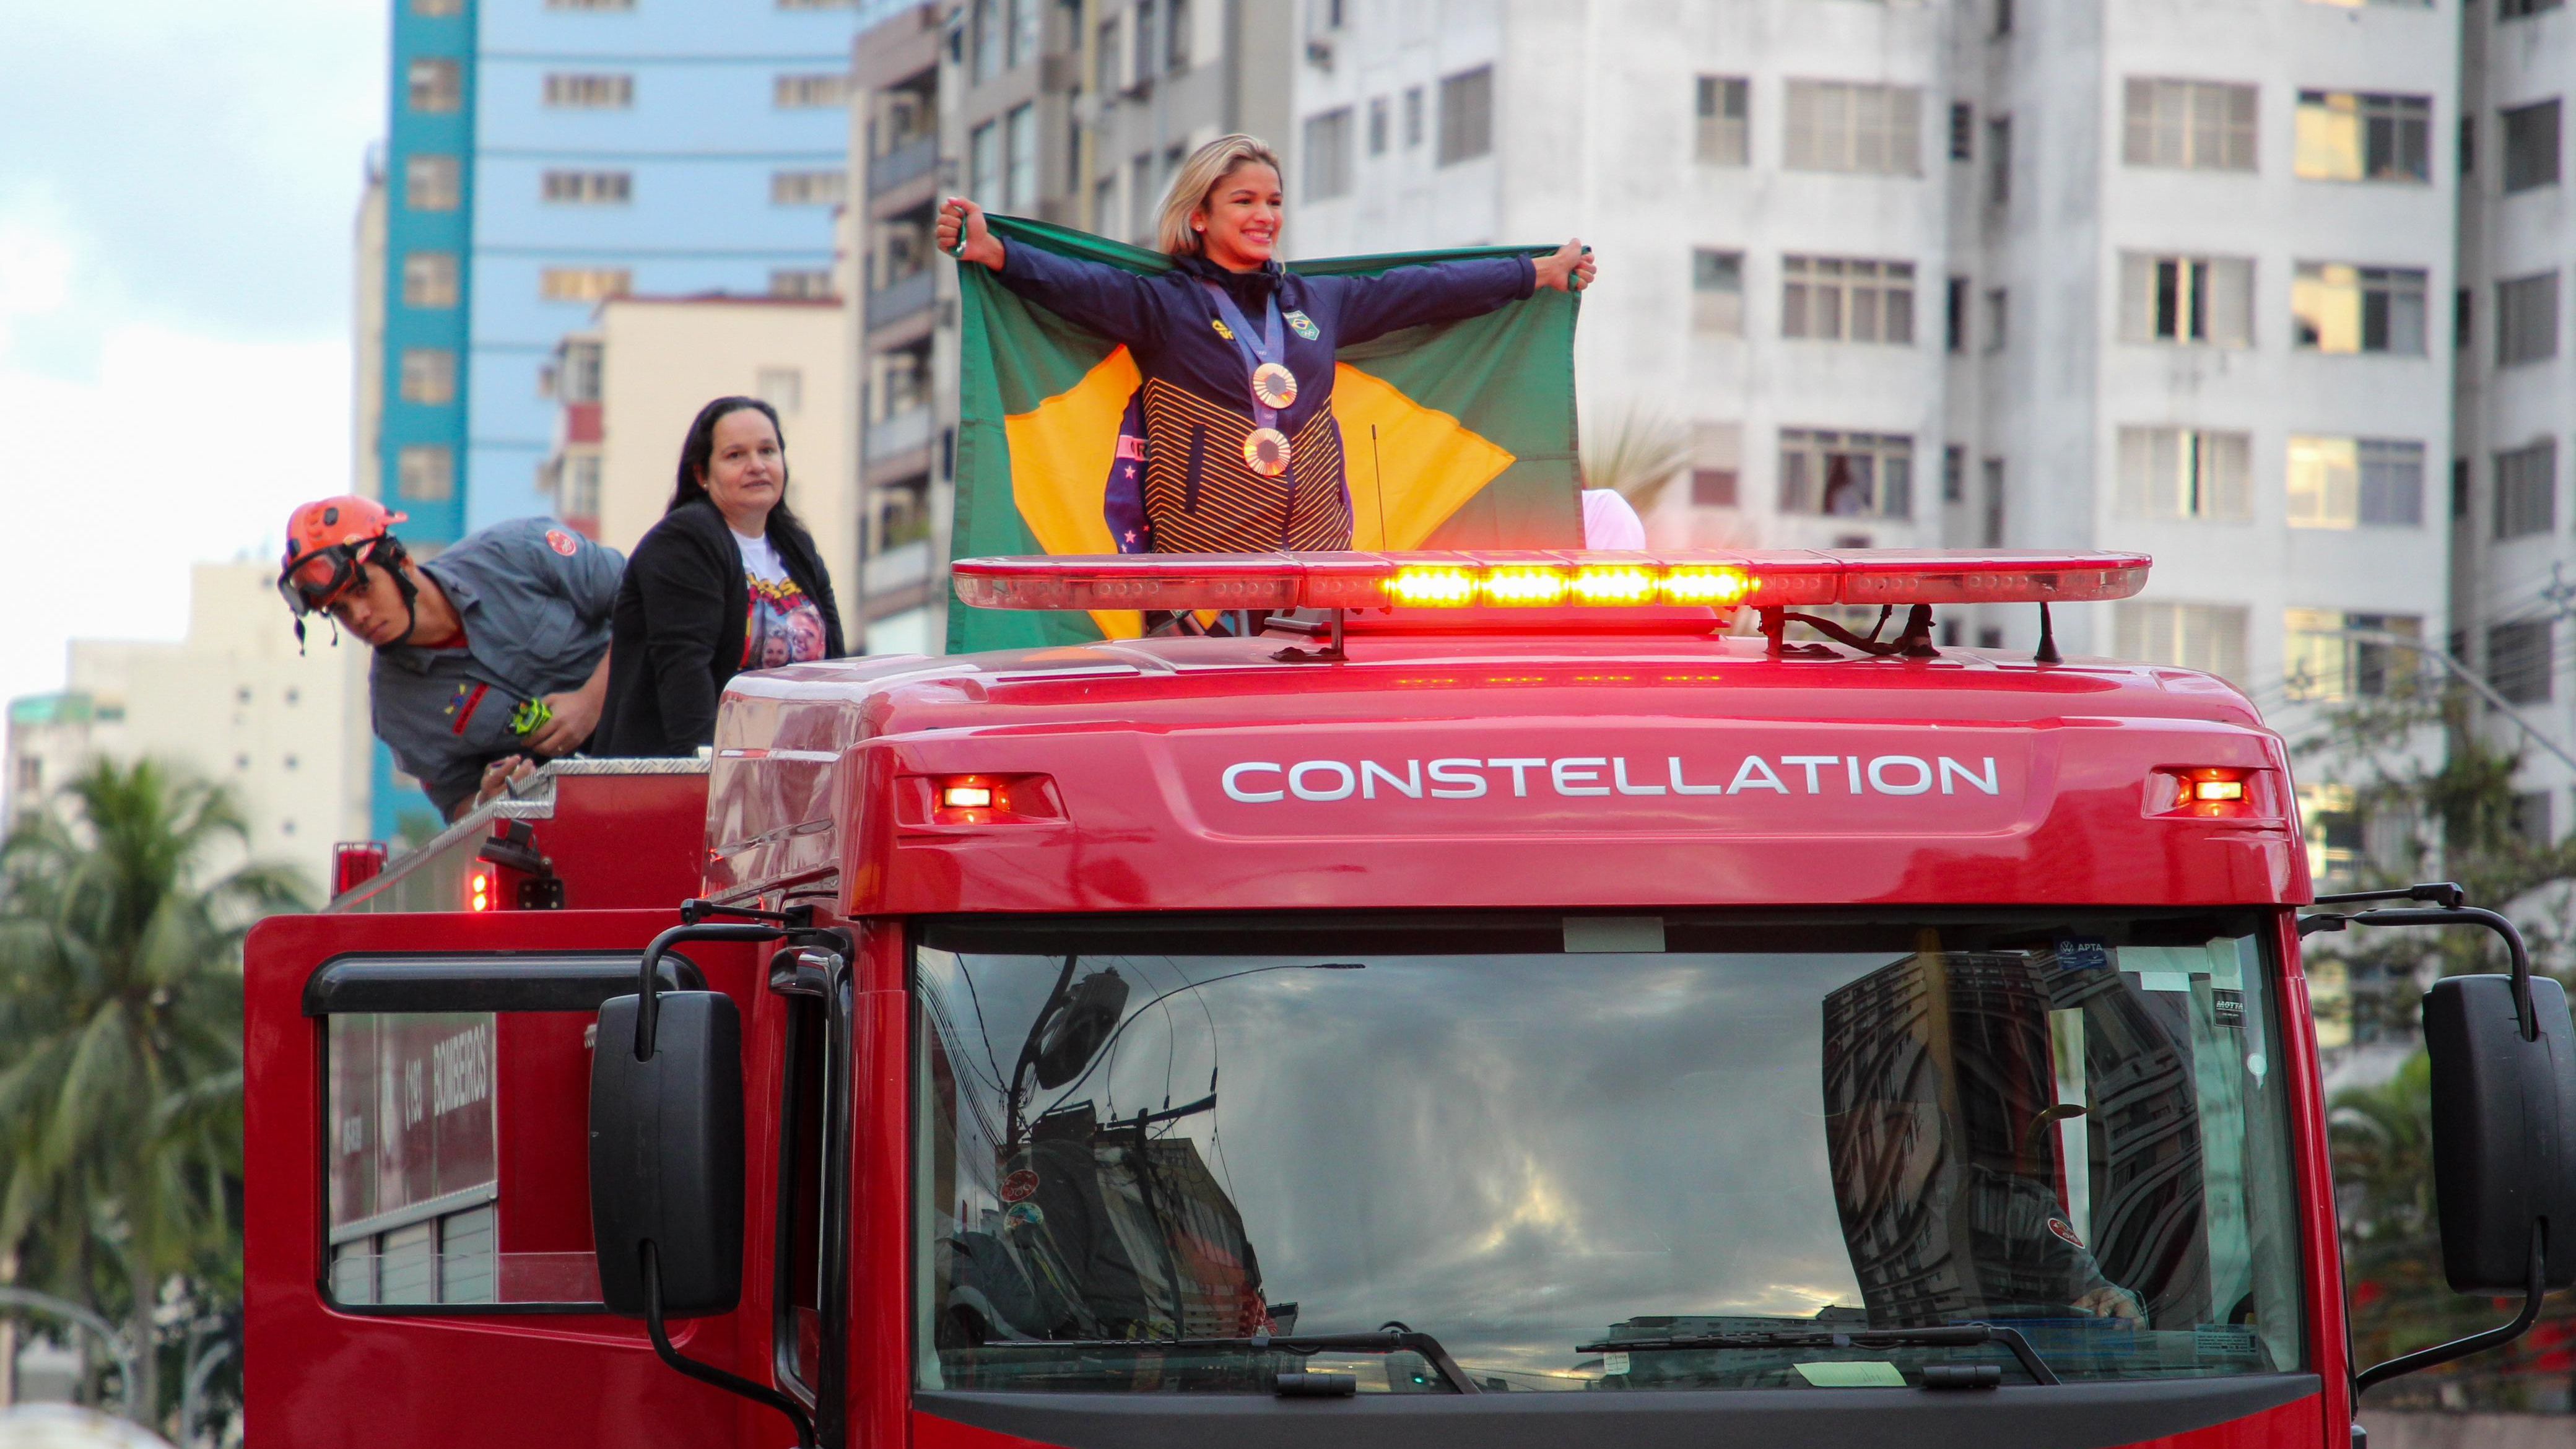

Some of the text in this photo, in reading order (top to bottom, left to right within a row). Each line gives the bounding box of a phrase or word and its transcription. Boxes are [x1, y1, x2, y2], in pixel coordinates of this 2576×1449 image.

[1221, 755, 1999, 803] CONSTELLATION
[2078, 943, 2103, 952] APTA
[433, 1023, 487, 1116] BOMBEIROS
